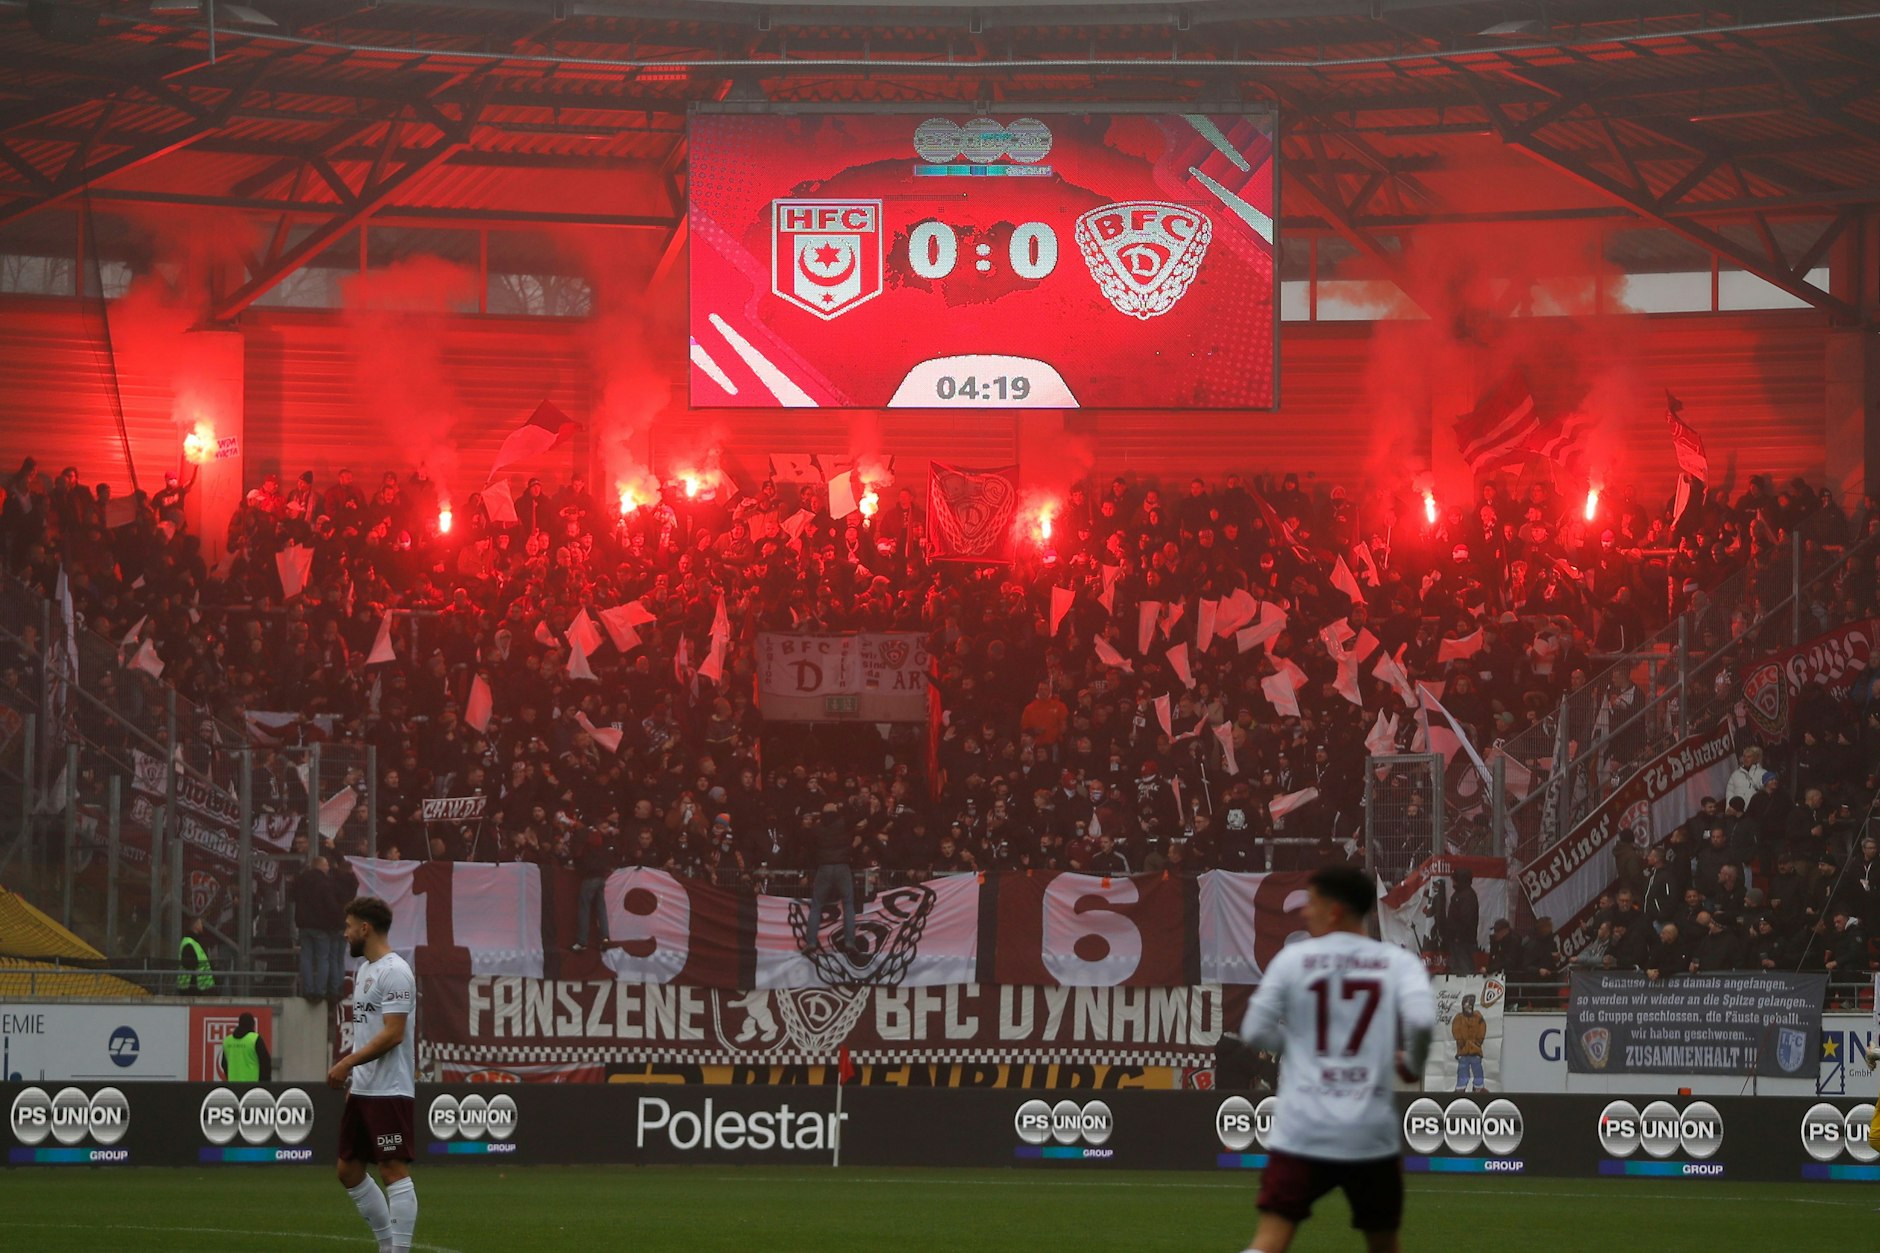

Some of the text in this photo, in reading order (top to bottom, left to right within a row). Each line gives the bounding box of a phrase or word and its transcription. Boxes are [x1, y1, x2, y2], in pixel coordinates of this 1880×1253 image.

[786, 208, 871, 230] HFC
[1095, 210, 1195, 242] BFC
[1122, 245, 1161, 277] D
[936, 376, 1031, 400] 04:19
[781, 640, 830, 655] BFC
[787, 659, 823, 692] D
[1745, 665, 1778, 696] BFC
[1523, 813, 1610, 901] Berliner
[1642, 769, 1668, 799] FC
[412, 861, 471, 976] 1
[601, 865, 691, 983] 9
[1042, 873, 1142, 986] 6
[1601, 977, 1645, 988] Genauso
[1668, 979, 1679, 988] es
[1683, 977, 1721, 989] damals
[468, 976, 1223, 1046] FANSZENE BFC DYNAMO
[803, 994, 832, 1021] D
[1577, 994, 1815, 1010] so werden wir wieder an die Spitze gelangen...
[2, 1014, 45, 1034] EMIE
[1308, 978, 1381, 1057] 17
[1579, 1010, 1595, 1022] die
[1598, 1011, 1633, 1025] Gruppe
[1705, 1011, 1721, 1022] die
[1725, 1011, 1760, 1023] Fäuste
[1631, 1028, 1755, 1041] wir haben geschworen...
[1625, 1046, 1740, 1067] ZUSAMMENHALT
[1744, 1048, 1758, 1068] !!!
[18, 1107, 122, 1126] PS UNION
[207, 1107, 306, 1125] PS UNION
[434, 1109, 511, 1124] PS UNION
[636, 1097, 849, 1149] Polestar
[1022, 1115, 1106, 1130] PS UNION
[1223, 1114, 1250, 1132] PS
[1411, 1117, 1515, 1136] PS UNION
[1606, 1119, 1715, 1139] PS UNION
[1809, 1123, 1839, 1141] PS
[377, 1134, 403, 1146] DWB
[487, 1144, 516, 1152] GROUP
[89, 1149, 129, 1161] GROUP
[275, 1149, 313, 1160] GROUP
[1083, 1149, 1113, 1158] GROUP
[1484, 1161, 1524, 1171] GROUP
[1682, 1163, 1723, 1174] GROUP
